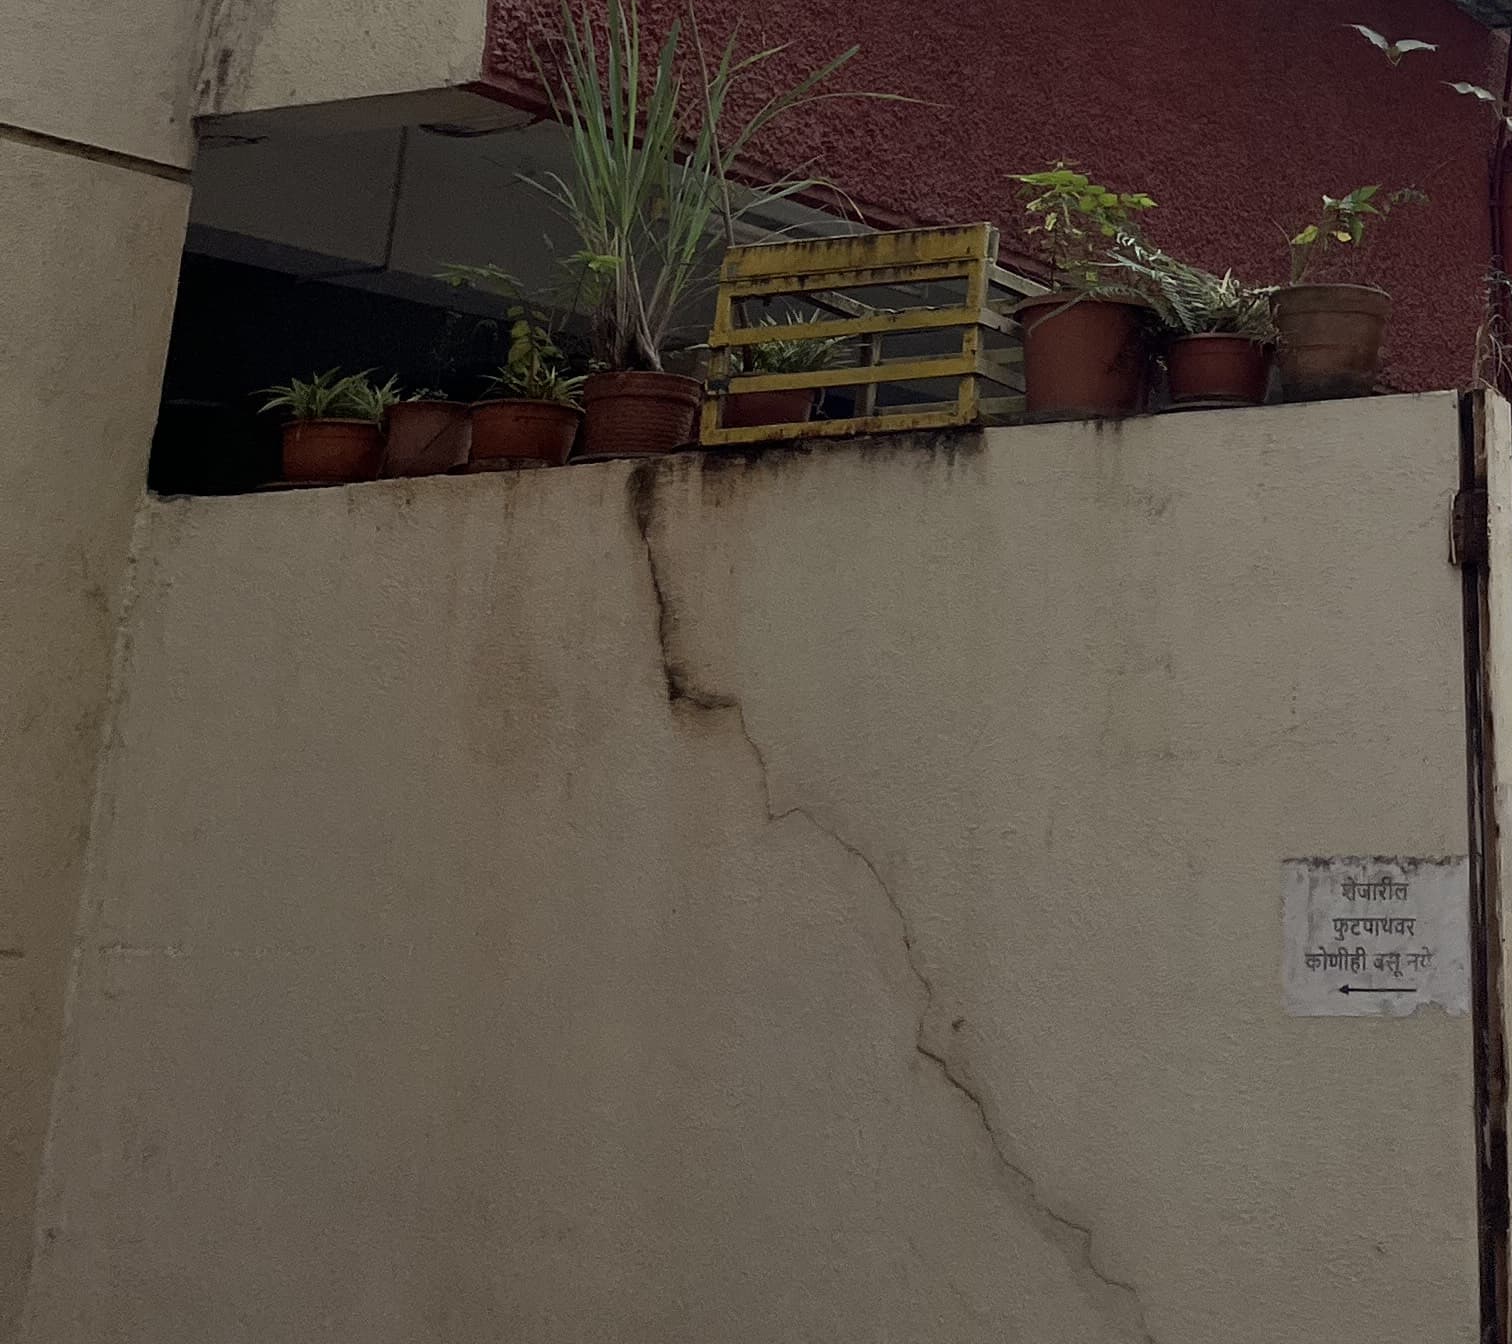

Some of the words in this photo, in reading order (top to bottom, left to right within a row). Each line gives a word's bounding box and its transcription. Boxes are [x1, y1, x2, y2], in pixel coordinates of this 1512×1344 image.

[1341, 876, 1409, 901] शेजारील
[1332, 917, 1416, 941] फुटपाथवर
[1304, 946, 1367, 973] कोणीही
